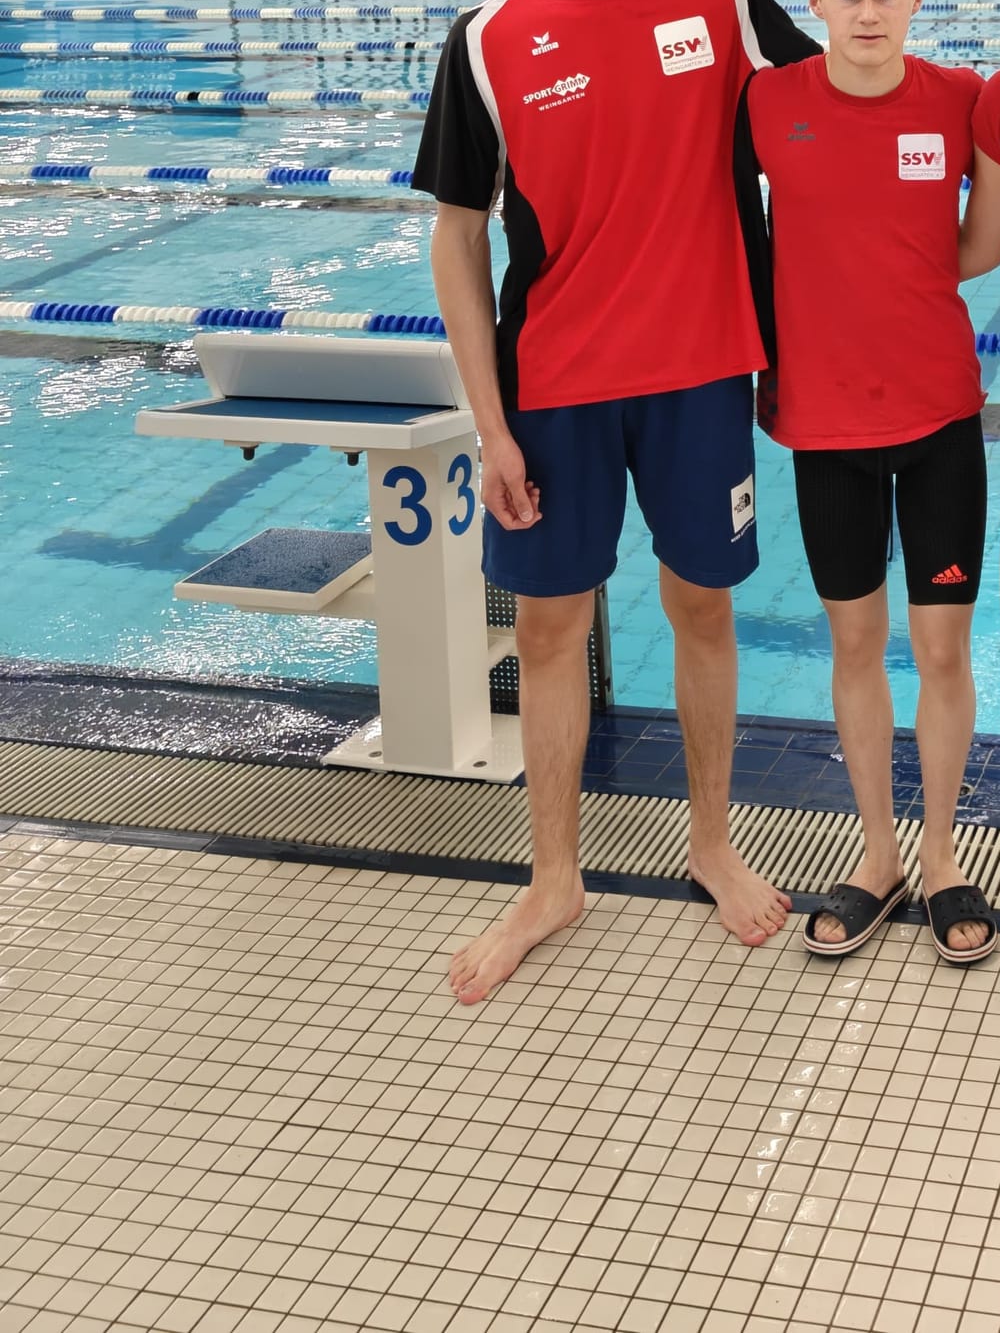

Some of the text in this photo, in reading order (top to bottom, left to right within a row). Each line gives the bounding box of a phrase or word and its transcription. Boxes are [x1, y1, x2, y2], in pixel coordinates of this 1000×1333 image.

[523, 76, 587, 104] SPORT GRIMM
[538, 92, 585, 111] WEINGARTEN
[382, 466, 432, 546] 3
[447, 453, 476, 536] 3
[932, 574, 968, 584] adidas
